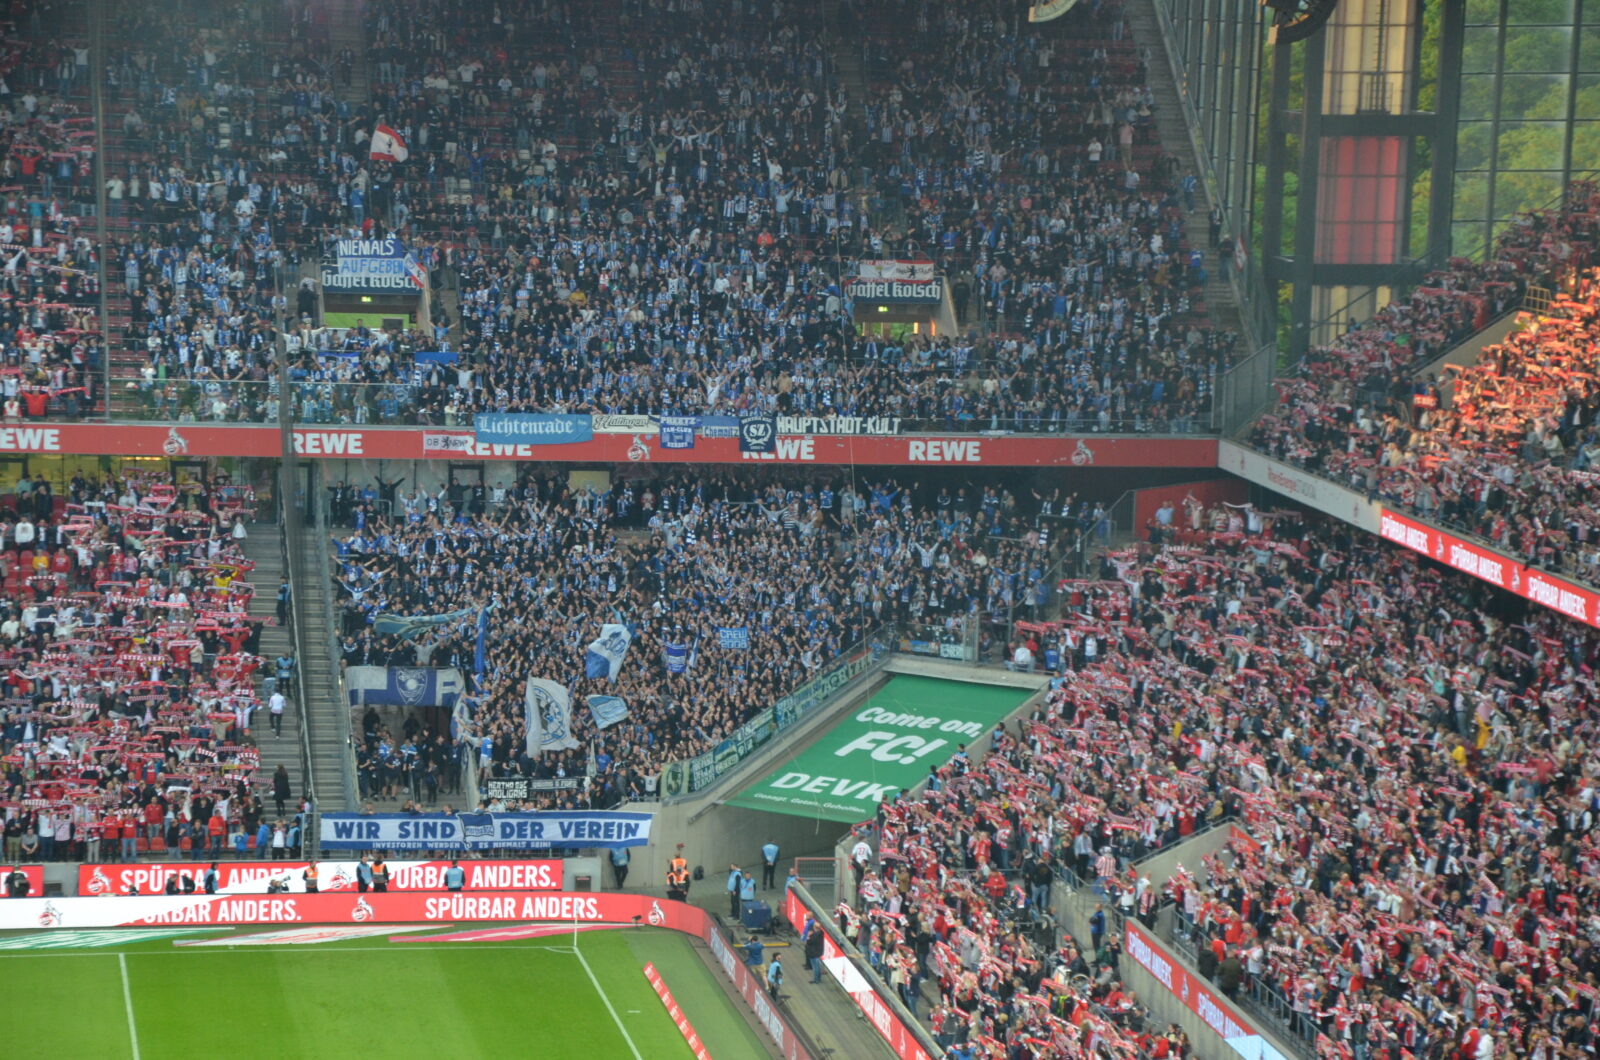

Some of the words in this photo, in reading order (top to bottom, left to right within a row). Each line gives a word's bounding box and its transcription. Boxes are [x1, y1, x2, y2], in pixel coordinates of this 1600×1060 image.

[340, 240, 394, 256] NIEMALS
[477, 416, 574, 435] Lichtenrade
[0, 428, 60, 450] EWE
[291, 432, 363, 454] REWE
[909, 440, 981, 461] REWE
[856, 707, 940, 729] Come
[939, 720, 983, 738] on,
[834, 731, 948, 765] FC!
[770, 772, 898, 803] DEVK
[333, 821, 381, 839] WIR
[398, 821, 456, 839] SIND
[500, 821, 544, 839] DER
[559, 821, 640, 840] VEREIN
[471, 865, 556, 887] ANDERS.
[218, 899, 302, 921] ANDERS.
[425, 894, 515, 919] SPÜRBAR
[522, 897, 602, 919] ANDERS.
